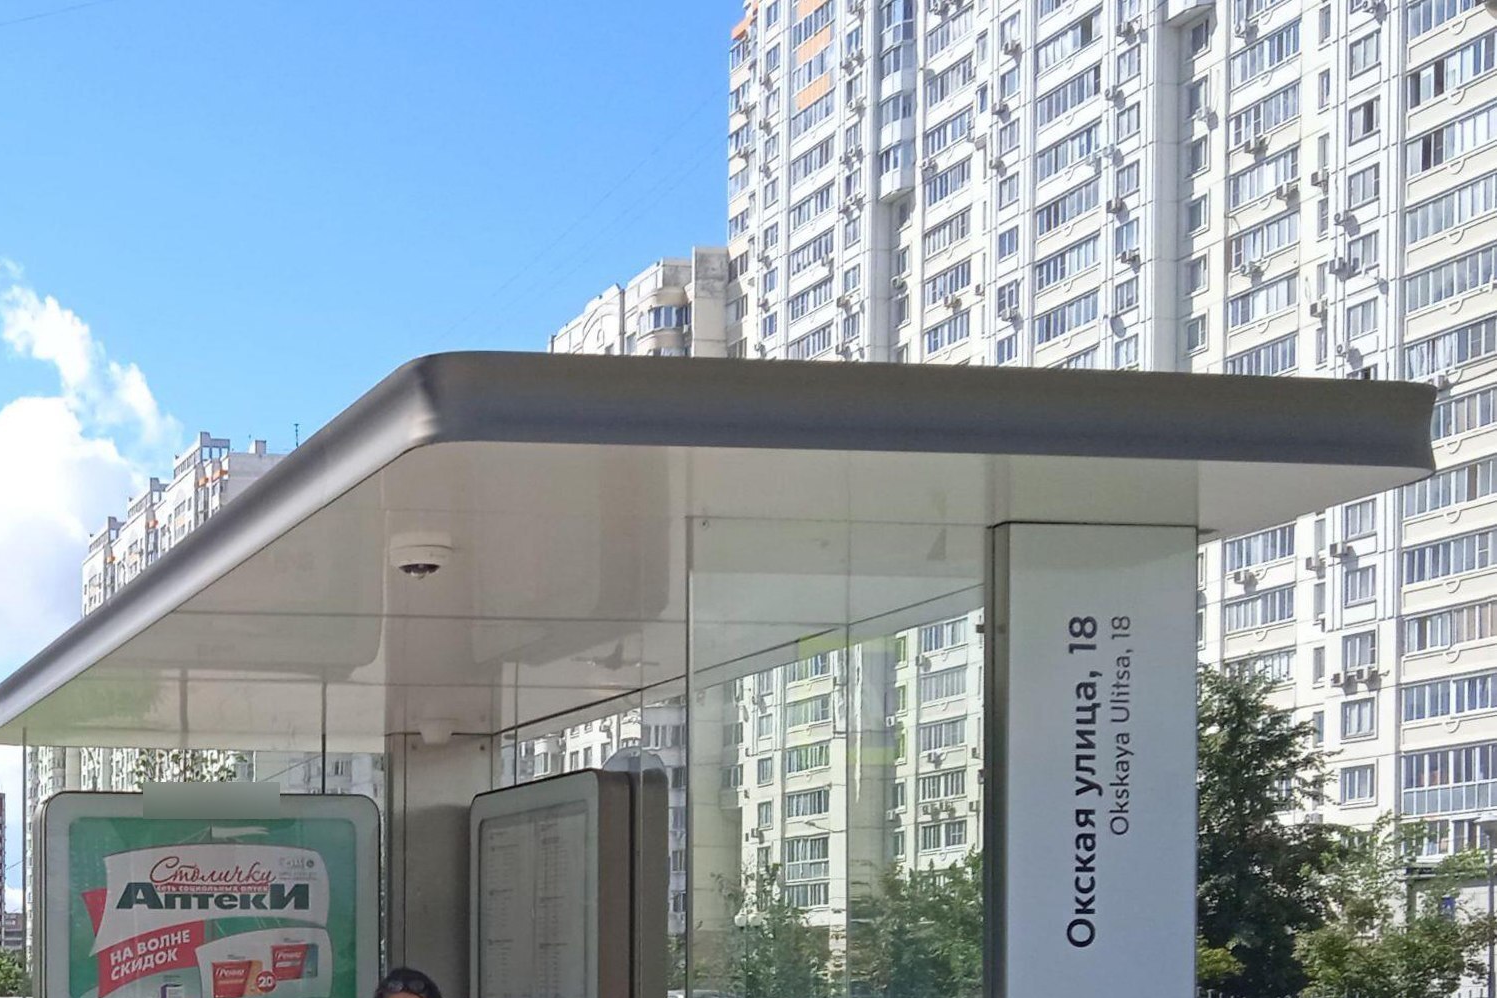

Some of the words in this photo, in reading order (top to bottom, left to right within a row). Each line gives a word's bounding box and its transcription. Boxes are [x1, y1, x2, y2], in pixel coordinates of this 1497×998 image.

[1068, 615, 1098, 655] 18
[1111, 614, 1131, 641] 18
[1110, 648, 1134, 723] Ulitsa,
[1074, 670, 1103, 797] улица,
[1109, 731, 1135, 836] Okskaya
[149, 855, 276, 884] Столички
[1066, 807, 1097, 948] Окская
[109, 945, 133, 967] НА
[136, 928, 191, 957] ВОЛНЕ
[110, 948, 179, 982] СКИДОК
